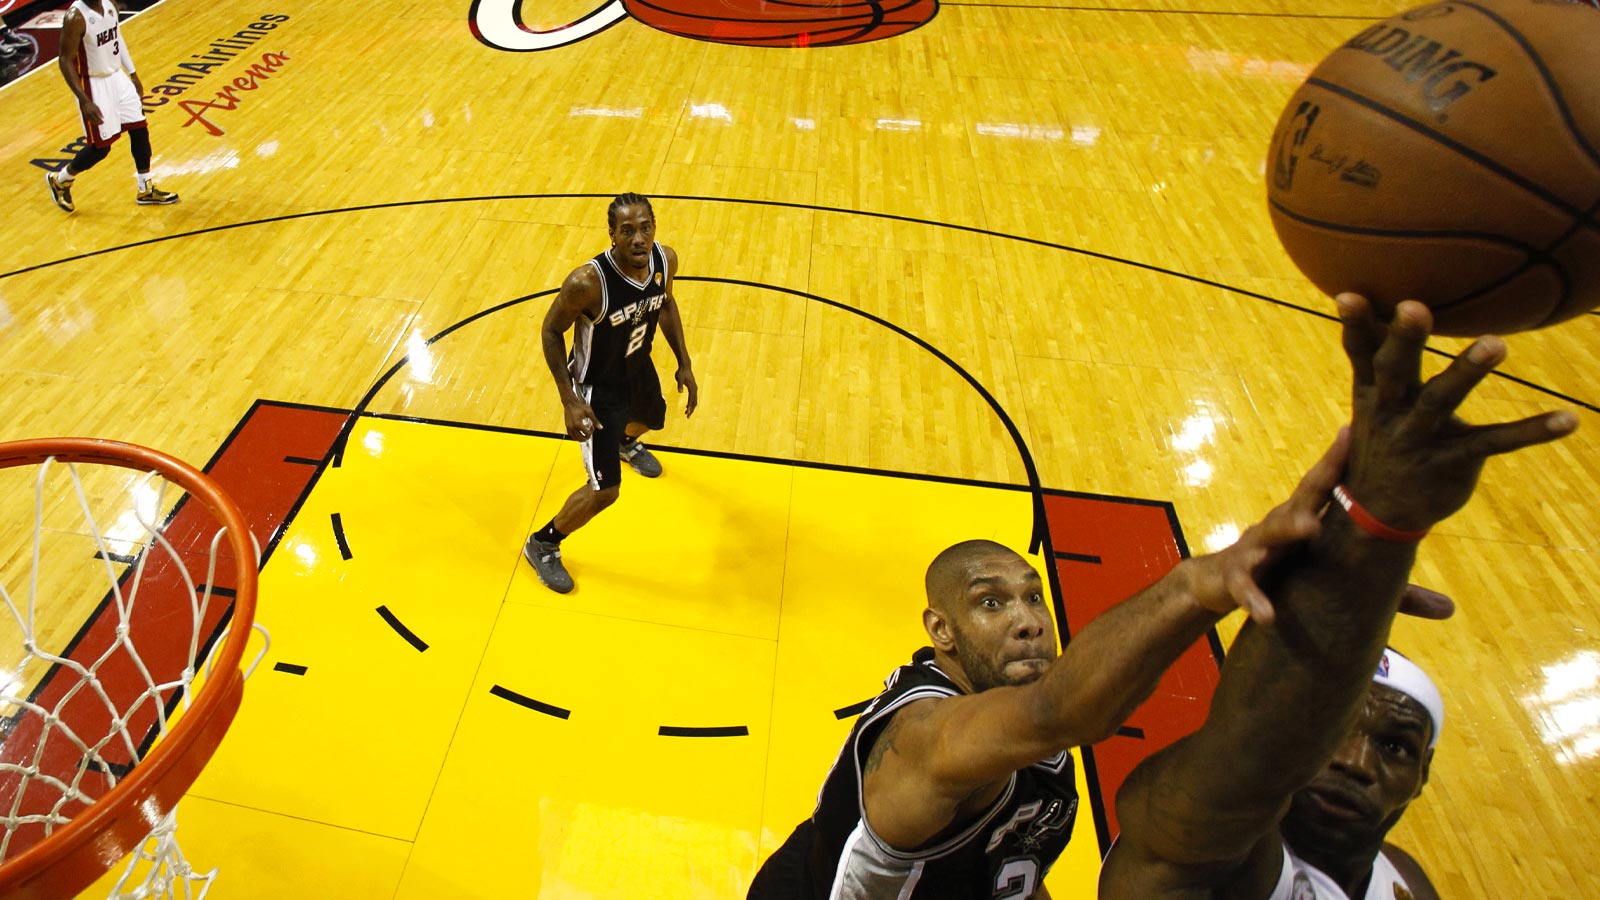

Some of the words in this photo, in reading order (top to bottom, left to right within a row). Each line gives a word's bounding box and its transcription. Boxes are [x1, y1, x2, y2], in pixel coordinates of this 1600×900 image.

[96, 22, 118, 47] HEAT
[112, 40, 119, 56] 3
[29, 13, 290, 173] AmcanAirlines
[177, 50, 291, 137] Arena
[1345, 23, 1497, 112] LDING
[624, 322, 648, 358] 2
